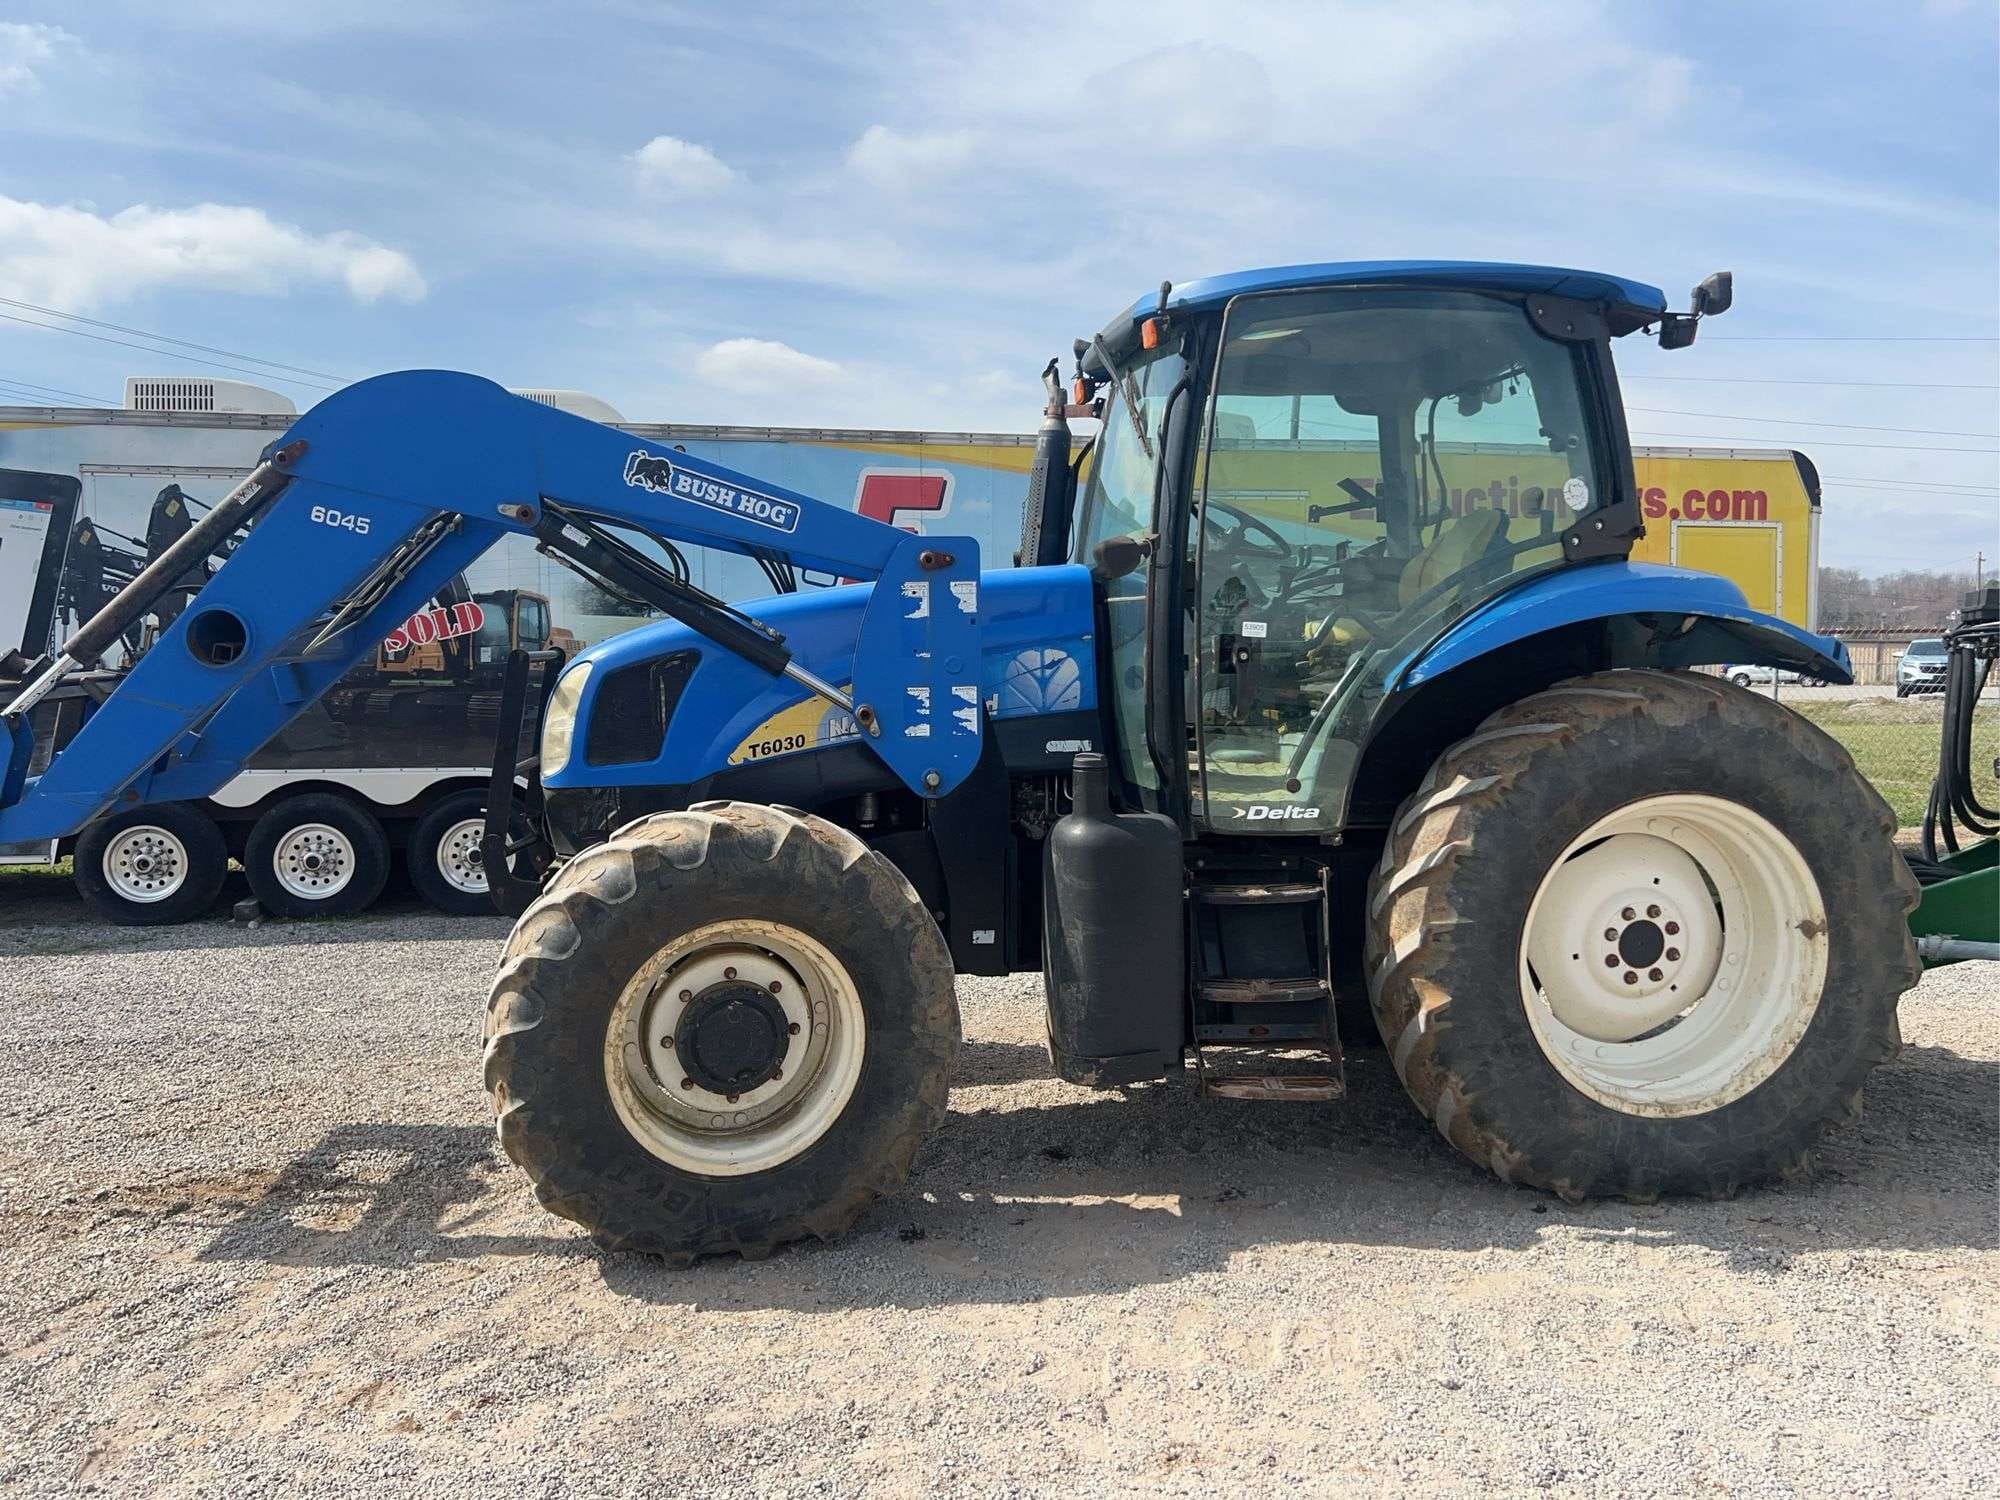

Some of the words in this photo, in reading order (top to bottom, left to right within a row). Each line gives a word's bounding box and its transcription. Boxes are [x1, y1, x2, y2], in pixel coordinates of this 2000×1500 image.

[675, 474, 735, 508] BUSH
[737, 492, 788, 524] HOG
[311, 505, 371, 535] 6045
[384, 601, 485, 653] SOLD
[748, 734, 806, 759] T6030
[1246, 804, 1320, 820] Delta
